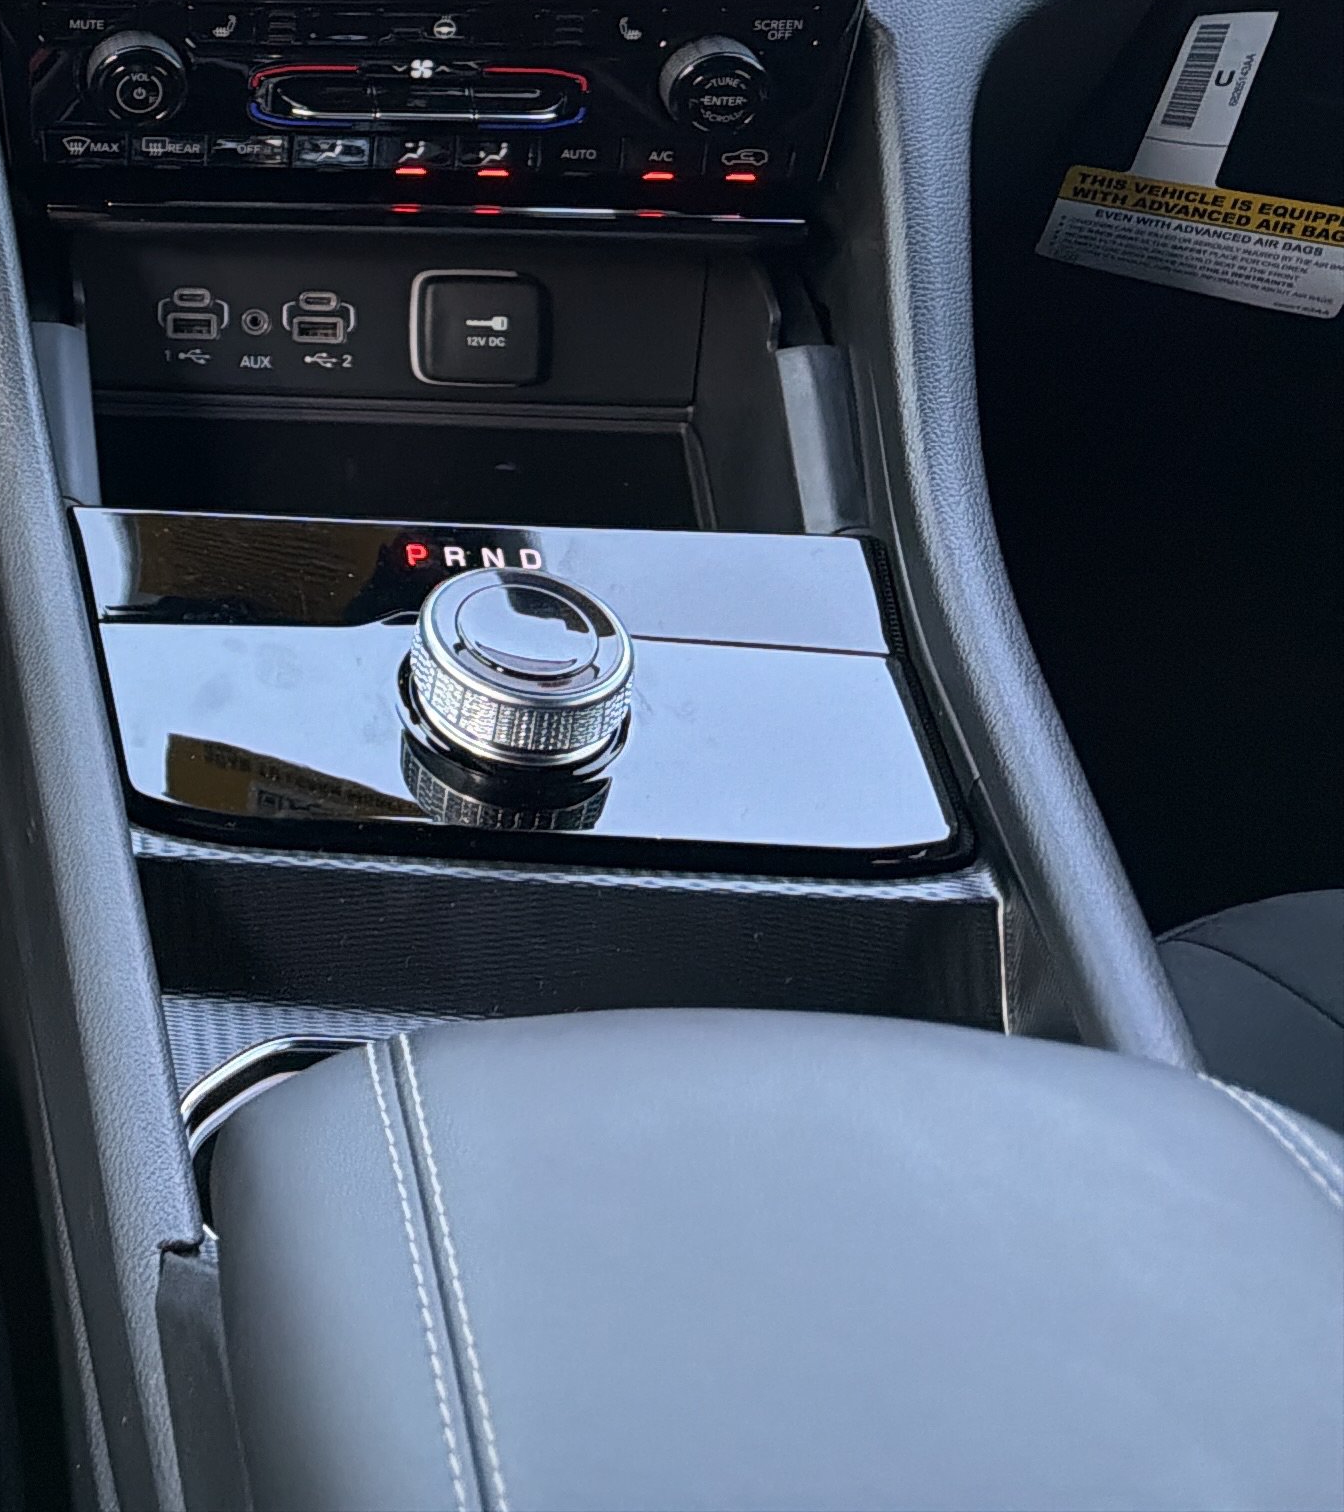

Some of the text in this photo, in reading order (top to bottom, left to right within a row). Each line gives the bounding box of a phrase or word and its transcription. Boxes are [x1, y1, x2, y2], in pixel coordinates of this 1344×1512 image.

[69, 19, 104, 30] MUTE
[753, 19, 804, 31] SCREEN
[767, 29, 793, 40] OFF
[130, 73, 151, 82] VOL
[710, 76, 741, 88] TUNE
[1214, 70, 1236, 87] U
[703, 96, 744, 106] ENTER
[89, 142, 119, 153] MAX
[167, 143, 201, 154] REAR
[236, 144, 262, 155] OFF
[560, 149, 598, 160] AUTO
[648, 150, 674, 162] A/C
[1079, 172, 1127, 191] THIS
[1134, 180, 1225, 208] VEHICLE
[1230, 198, 1252, 213] IS
[1072, 186, 1128, 206] WITH
[1131, 197, 1252, 227] ADVANCED
[1255, 218, 1296, 236] AIR
[1095, 208, 1134, 224] EVEN
[1135, 215, 1171, 231] WITH
[1173, 222, 1252, 244] ADVANCED
[1254, 237, 1280, 249] AIR
[1281, 241, 1324, 257] BAGS
[466, 336, 506, 347] 12V DC
[239, 355, 273, 369] AUX
[341, 354, 352, 368] 2
[405, 543, 542, 570] P R N D
